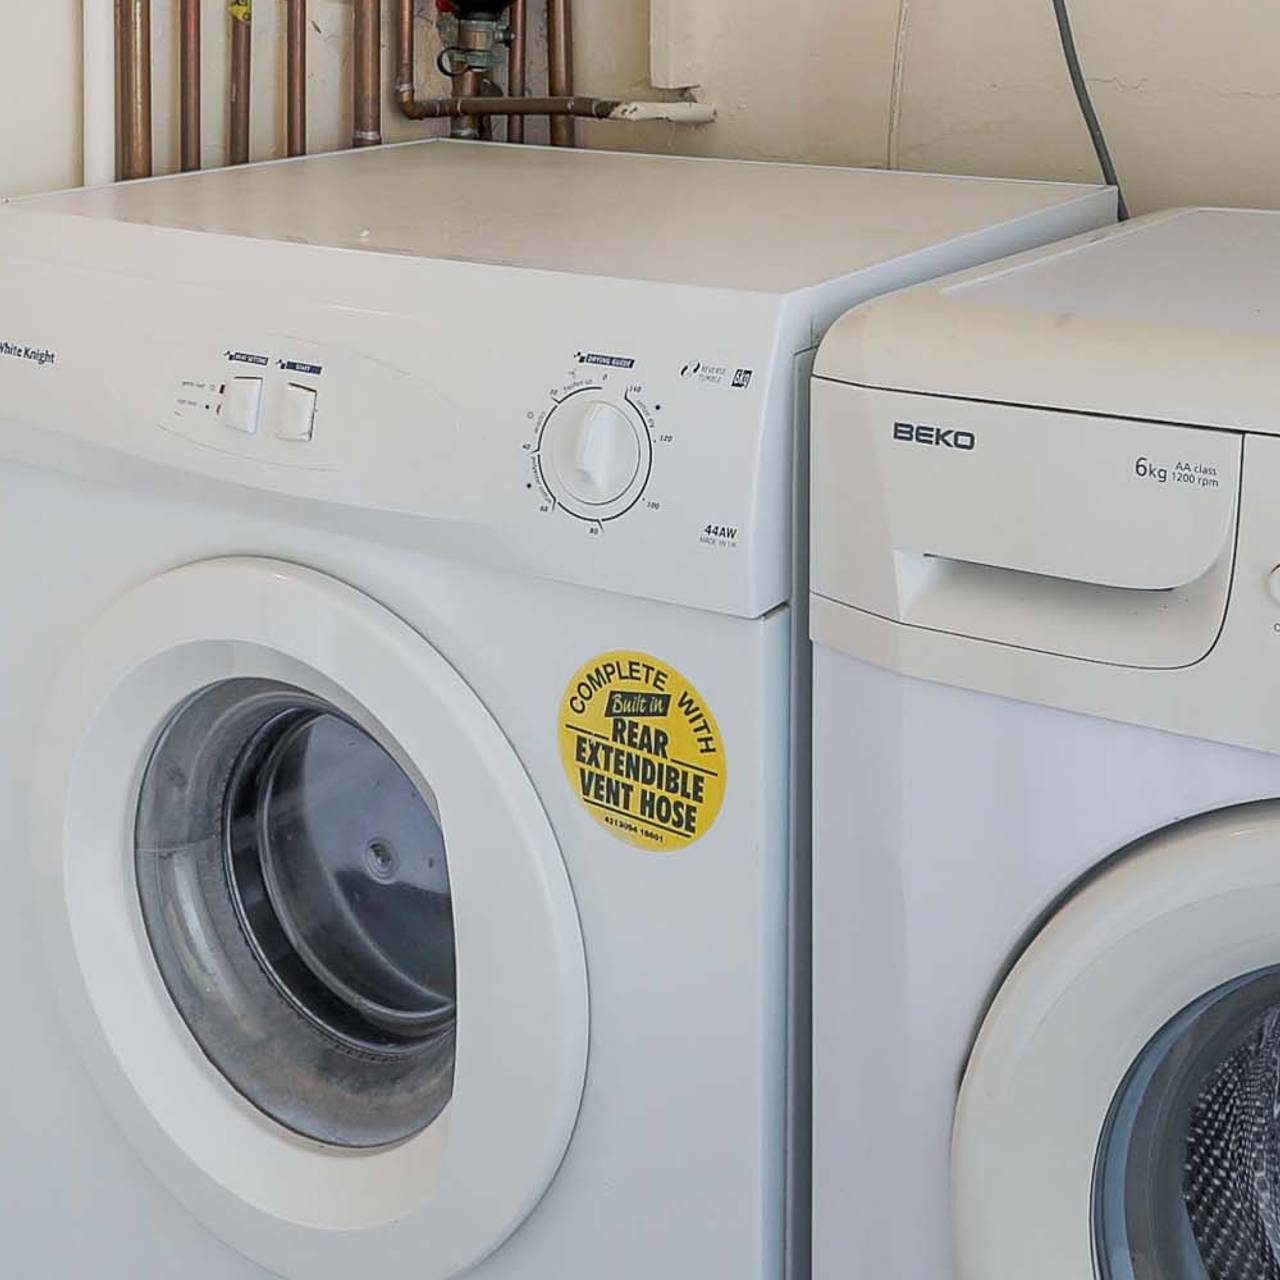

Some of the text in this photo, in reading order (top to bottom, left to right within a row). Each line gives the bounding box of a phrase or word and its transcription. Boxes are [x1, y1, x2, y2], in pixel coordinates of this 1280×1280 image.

[24, 347, 55, 365] Knight
[660, 434, 673, 443] 120
[893, 421, 976, 450] BEKO
[1135, 456, 1168, 483] 6kg
[1172, 471, 1219, 487] 1200 rpm
[1175, 461, 1217, 476] AA class
[704, 524, 737, 539] 44AW
[570, 661, 716, 754] COMPLETE WITH
[611, 693, 665, 714] Built in
[612, 718, 669, 759] REAR
[575, 735, 704, 803] EXTENDIBLE
[579, 768, 697, 834] VENT HOSE
